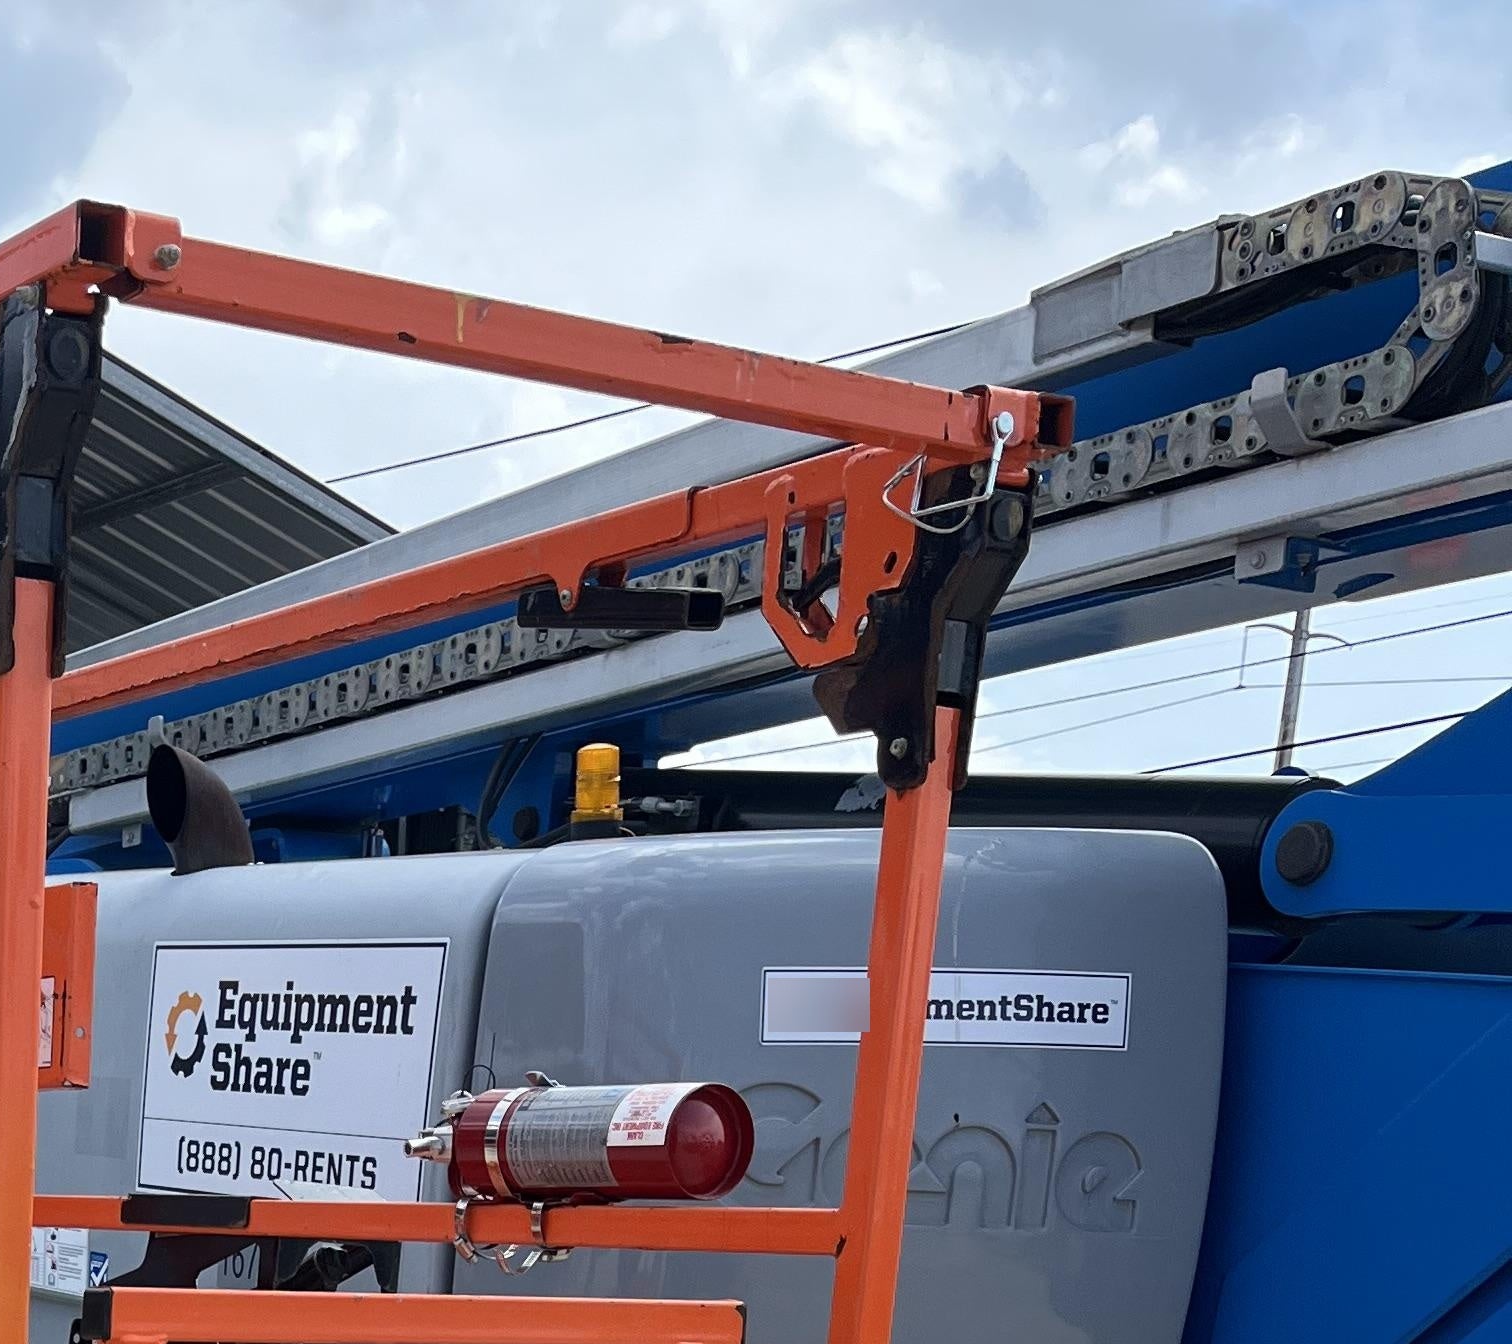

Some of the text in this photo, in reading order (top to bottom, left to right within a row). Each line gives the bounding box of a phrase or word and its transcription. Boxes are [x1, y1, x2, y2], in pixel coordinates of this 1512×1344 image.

[215, 980, 417, 1044] Equipment
[925, 994, 1109, 1025] mentShare
[210, 1043, 312, 1096] Share
[178, 1136, 378, 1190] (888) 80-RENTS
